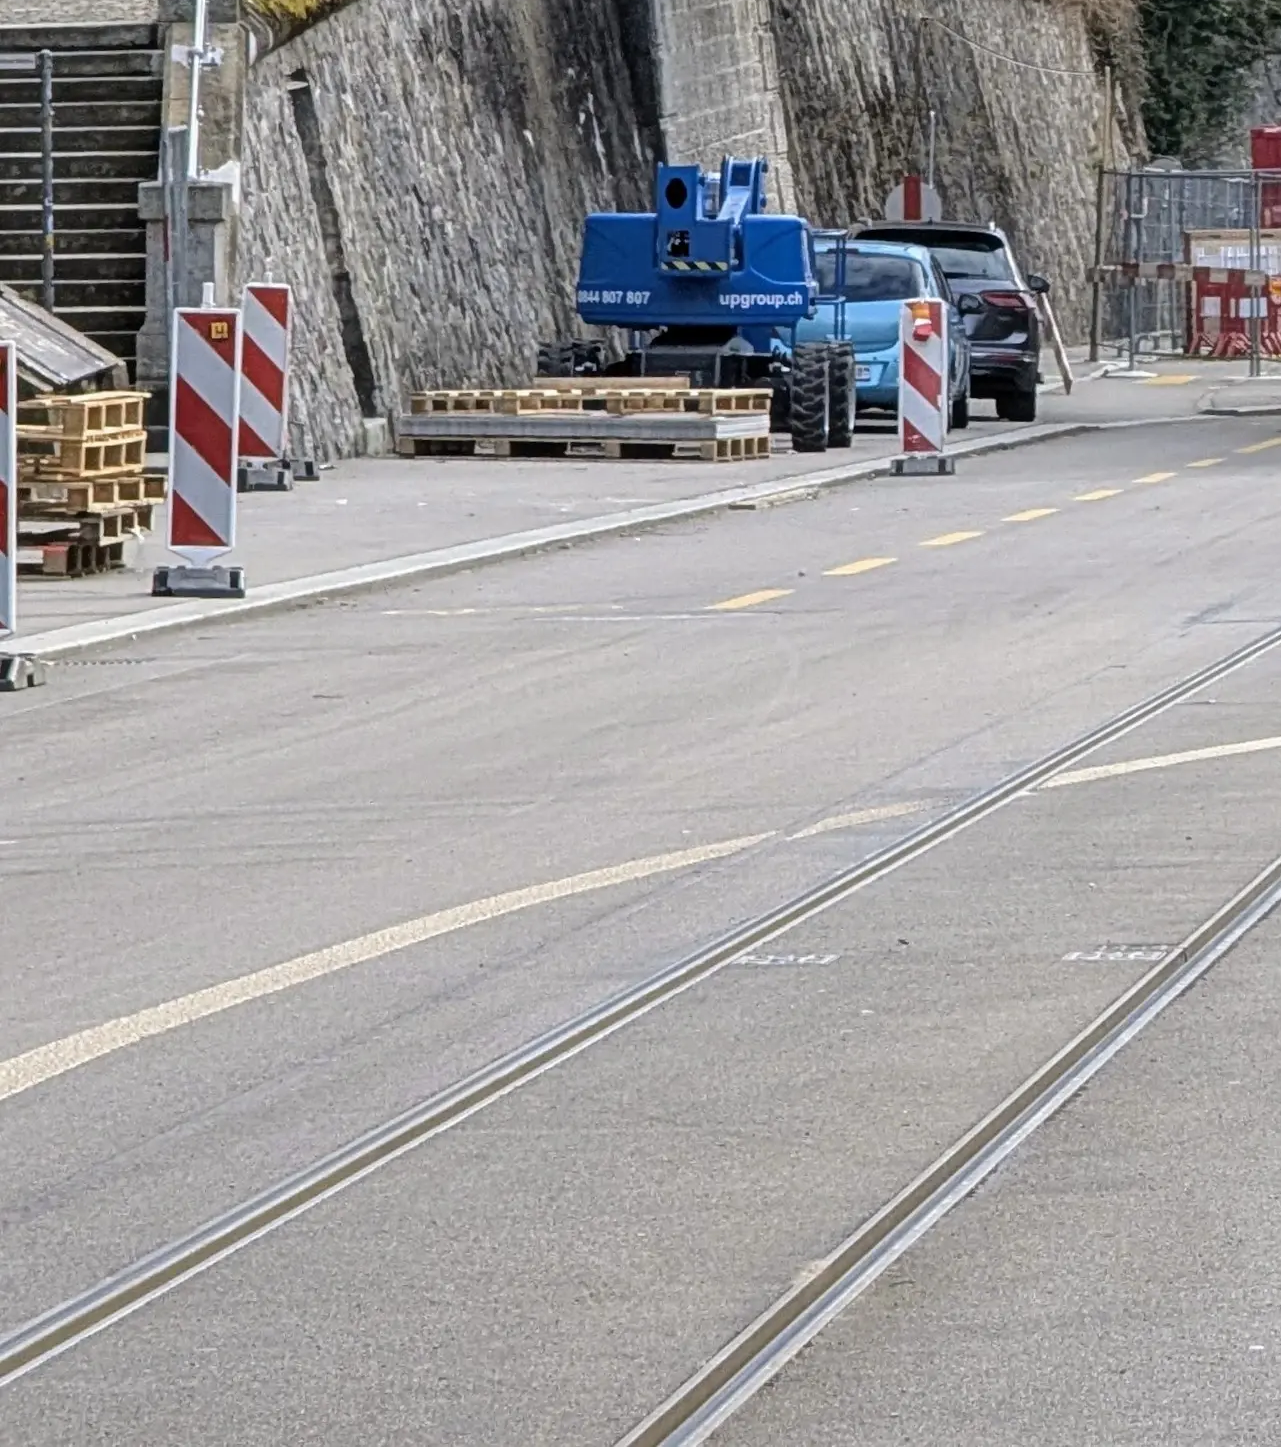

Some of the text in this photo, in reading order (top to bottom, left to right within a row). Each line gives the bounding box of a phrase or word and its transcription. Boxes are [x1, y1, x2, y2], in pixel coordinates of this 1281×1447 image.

[602, 290, 624, 304] 807
[626, 290, 652, 305] 807
[719, 291, 803, 310] upgroup.ch
